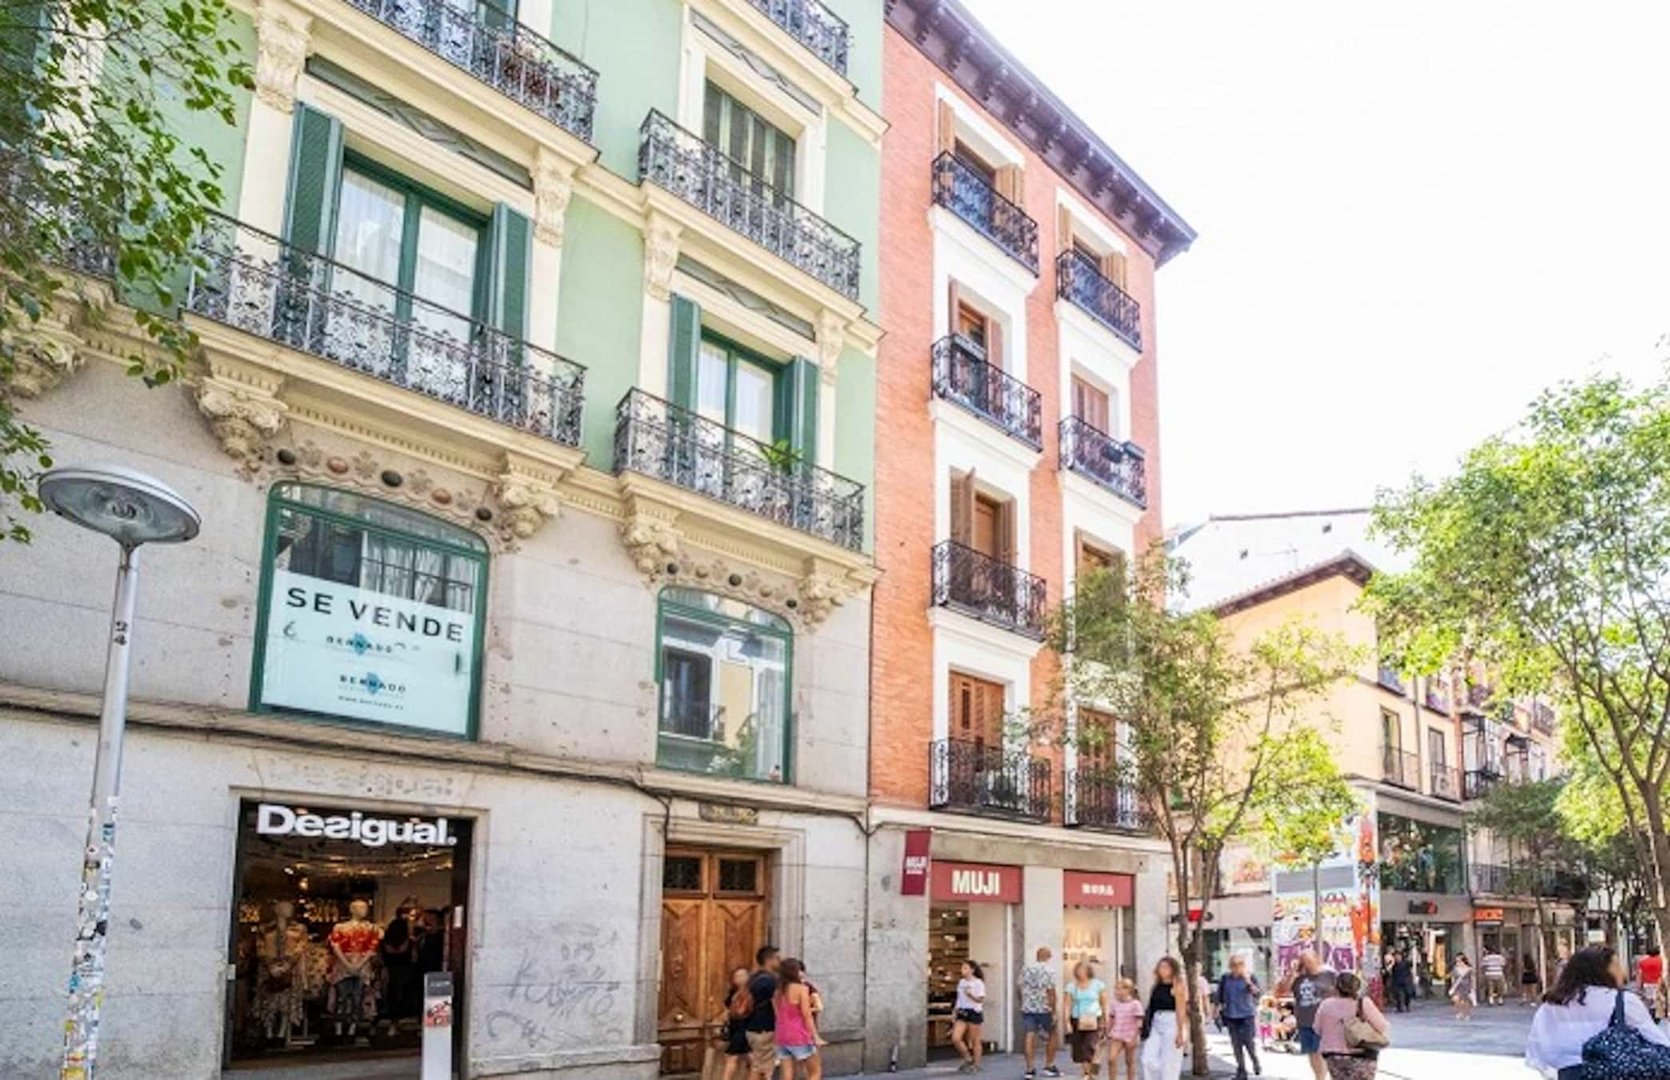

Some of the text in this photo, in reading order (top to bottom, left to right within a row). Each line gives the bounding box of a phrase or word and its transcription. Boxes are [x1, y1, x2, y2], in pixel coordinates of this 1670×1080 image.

[286, 587, 465, 643] SE VENDE
[951, 869, 1001, 897] MUJI
